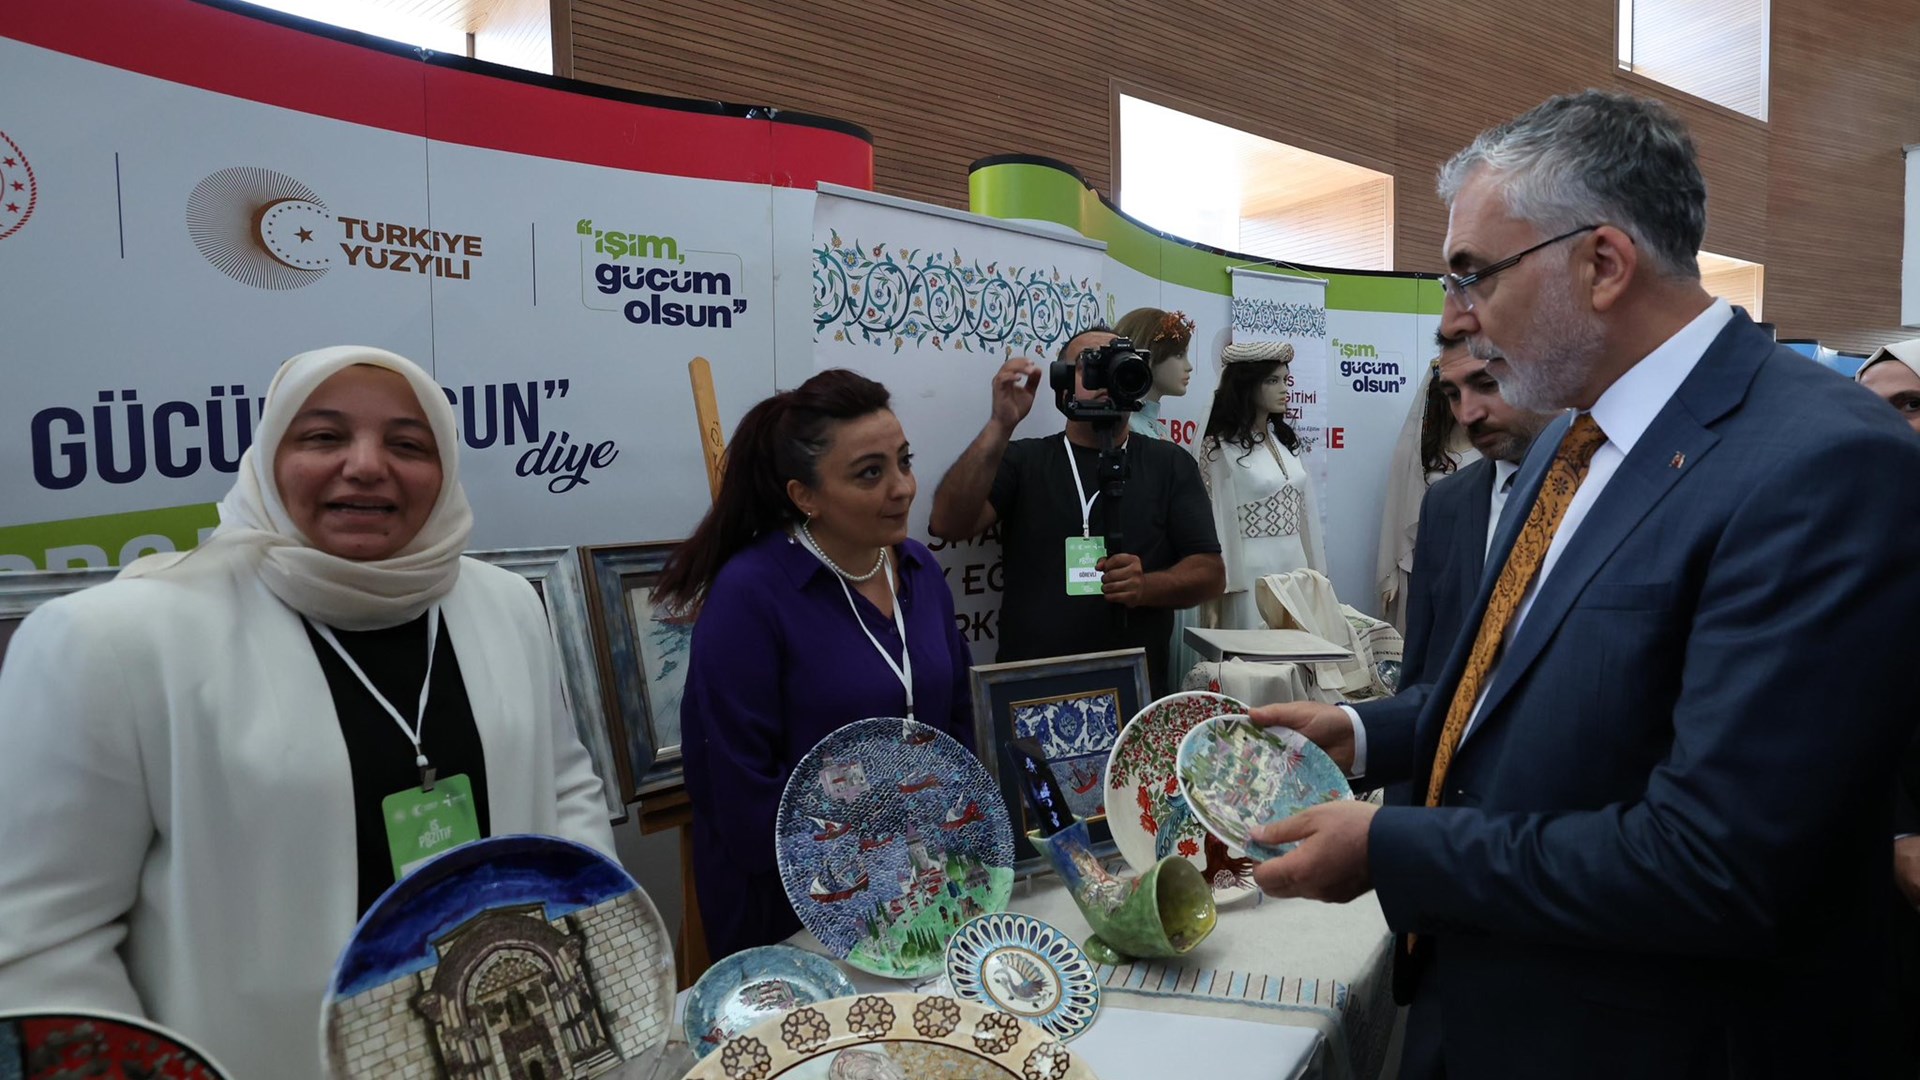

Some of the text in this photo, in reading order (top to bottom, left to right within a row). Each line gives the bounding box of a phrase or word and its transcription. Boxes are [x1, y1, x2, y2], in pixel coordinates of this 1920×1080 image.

[338, 216, 483, 257] TÜRKİYE
[340, 242, 470, 280] YÜZYILI
[595, 263, 731, 295] gücüm
[1340, 360, 1399, 377] gücüm
[31, 385, 265, 490] GÜCÜ
[515, 430, 619, 494] diye
